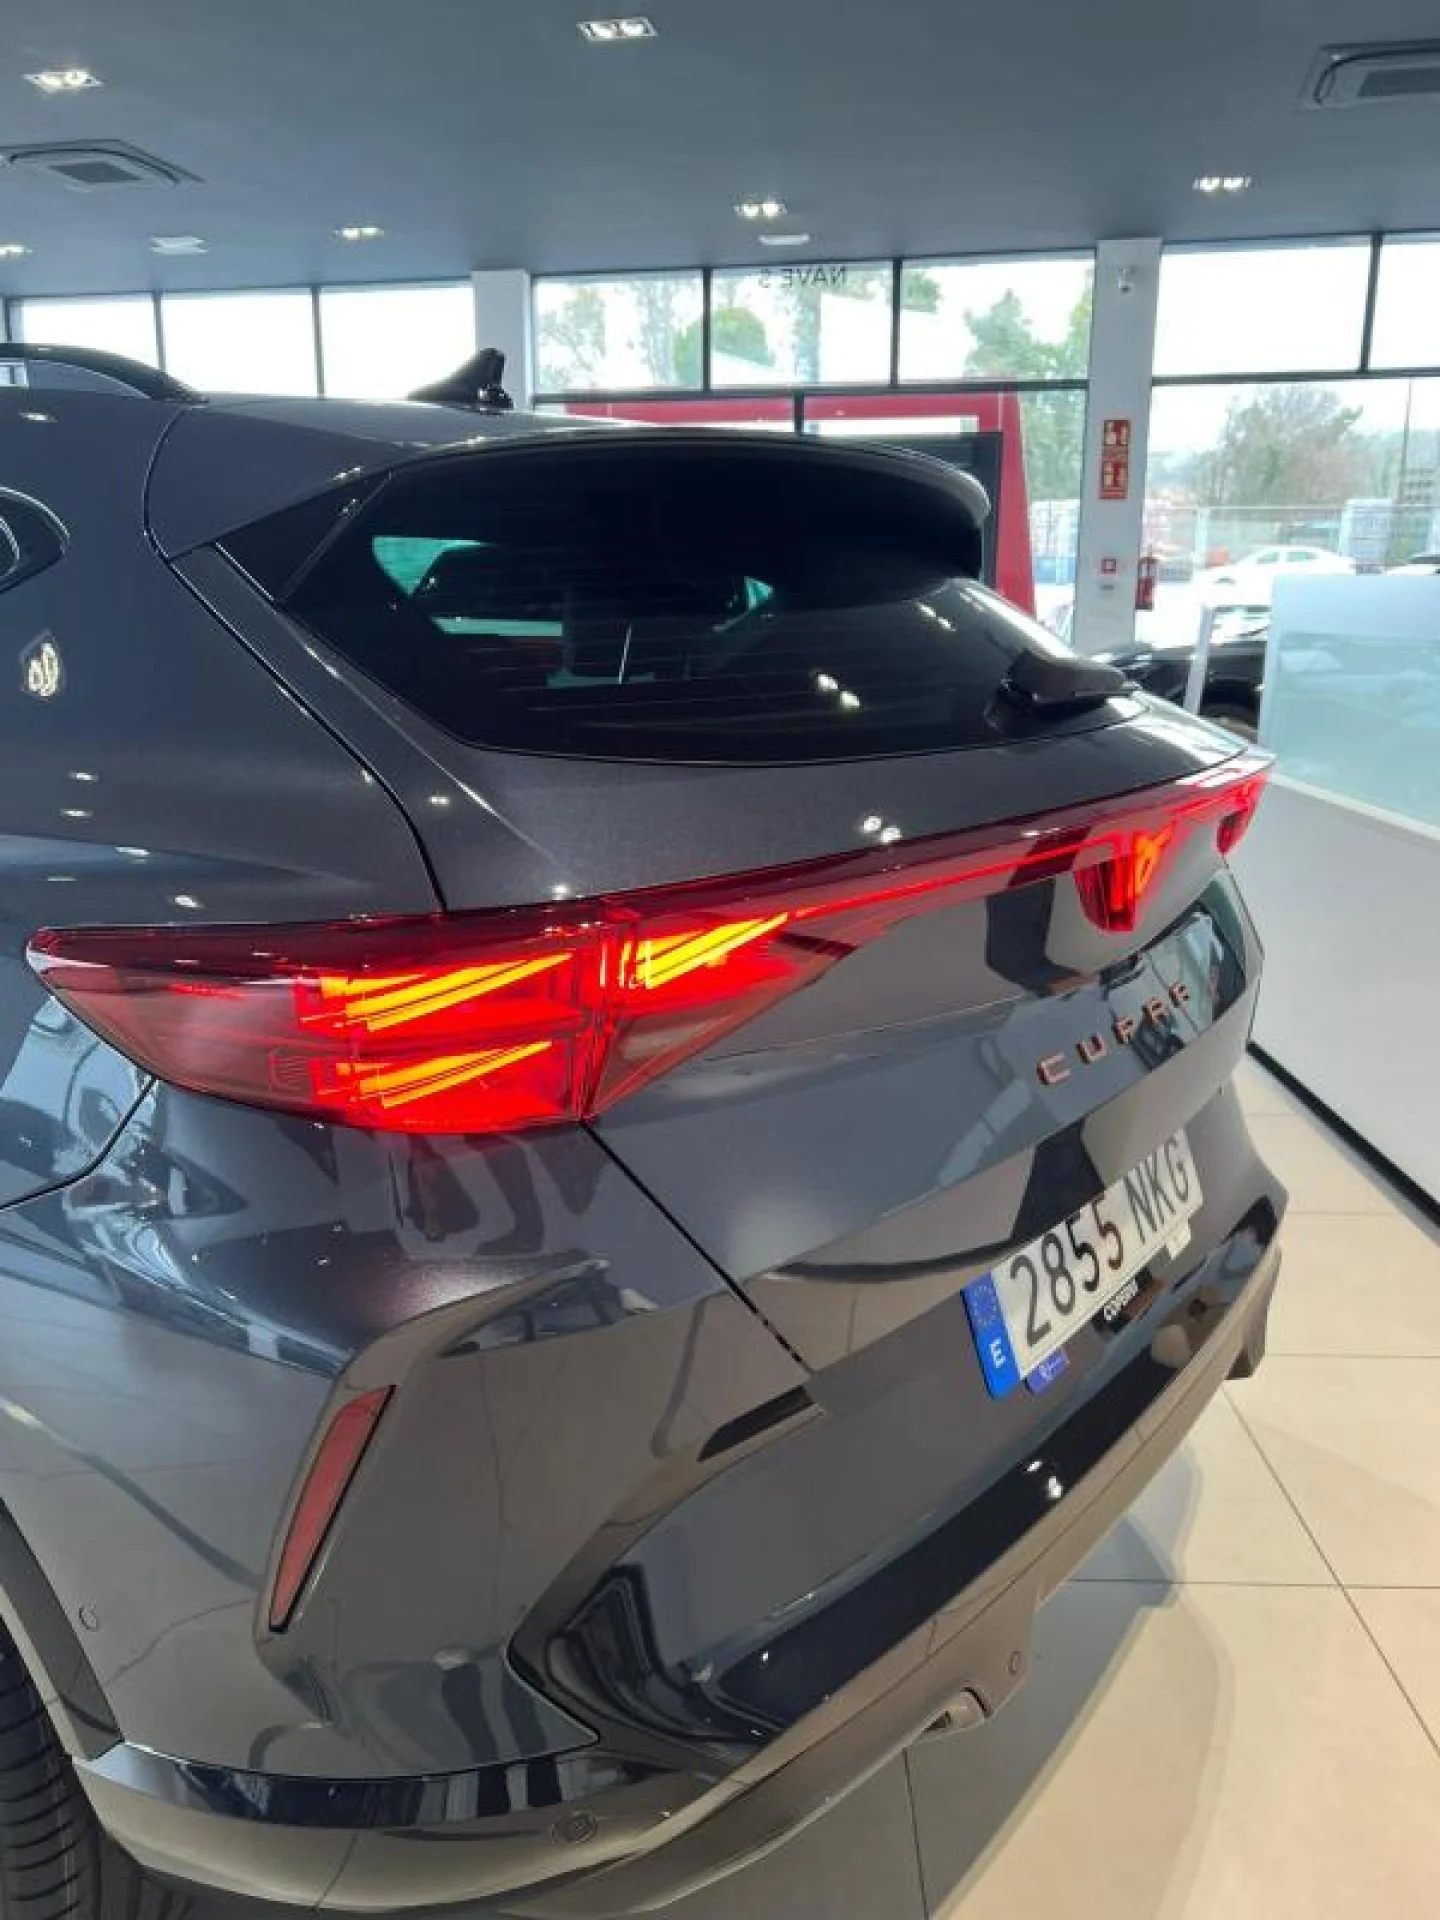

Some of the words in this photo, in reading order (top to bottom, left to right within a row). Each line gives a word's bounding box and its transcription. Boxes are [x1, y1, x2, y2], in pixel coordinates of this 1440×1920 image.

[1009, 1190, 1124, 1346] 2855
[1122, 1136, 1189, 1245] NKG
[988, 1338, 1007, 1369] E
